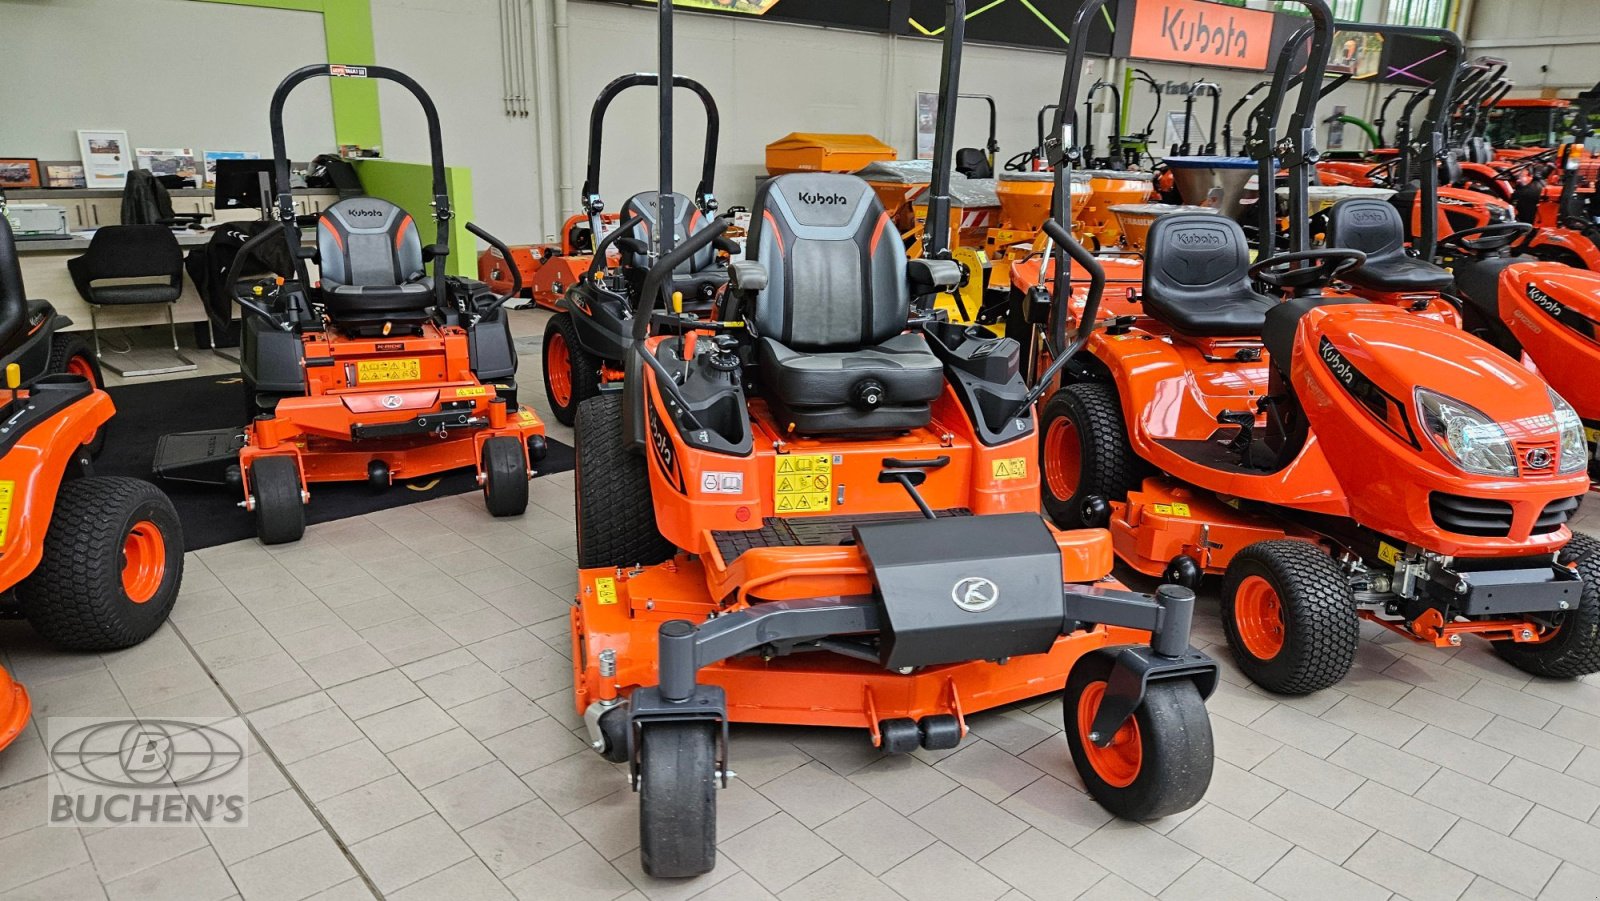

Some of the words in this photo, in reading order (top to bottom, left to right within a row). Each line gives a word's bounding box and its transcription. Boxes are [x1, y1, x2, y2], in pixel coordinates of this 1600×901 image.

[1161, 6, 1247, 58] Kubota
[799, 192, 847, 205] Kubota
[348, 209, 383, 217] Kubota
[1177, 233, 1219, 244] Kubota
[1528, 287, 1561, 315] Kubota
[1322, 342, 1353, 383] Kubota
